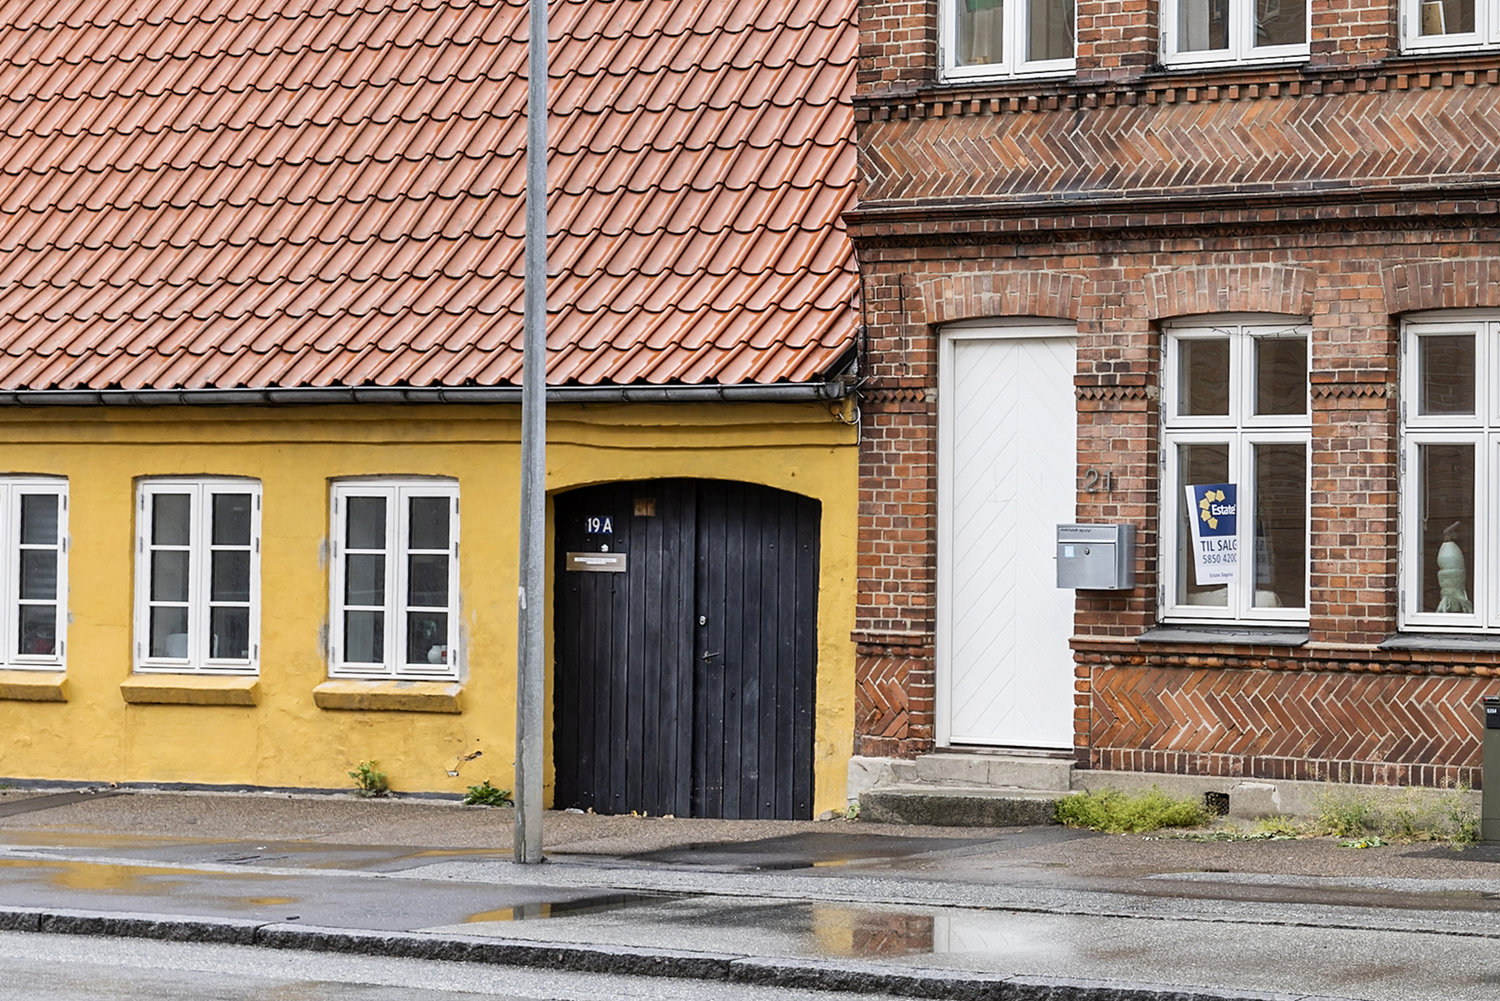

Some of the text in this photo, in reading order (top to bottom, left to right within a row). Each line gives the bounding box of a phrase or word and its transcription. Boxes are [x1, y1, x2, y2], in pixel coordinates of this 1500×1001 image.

[1085, 468, 1112, 493] 21
[1211, 504, 1235, 515] Estate
[587, 517, 613, 533] 19 A
[1200, 540, 1215, 551] TIL
[1202, 554, 1221, 564] 5850
